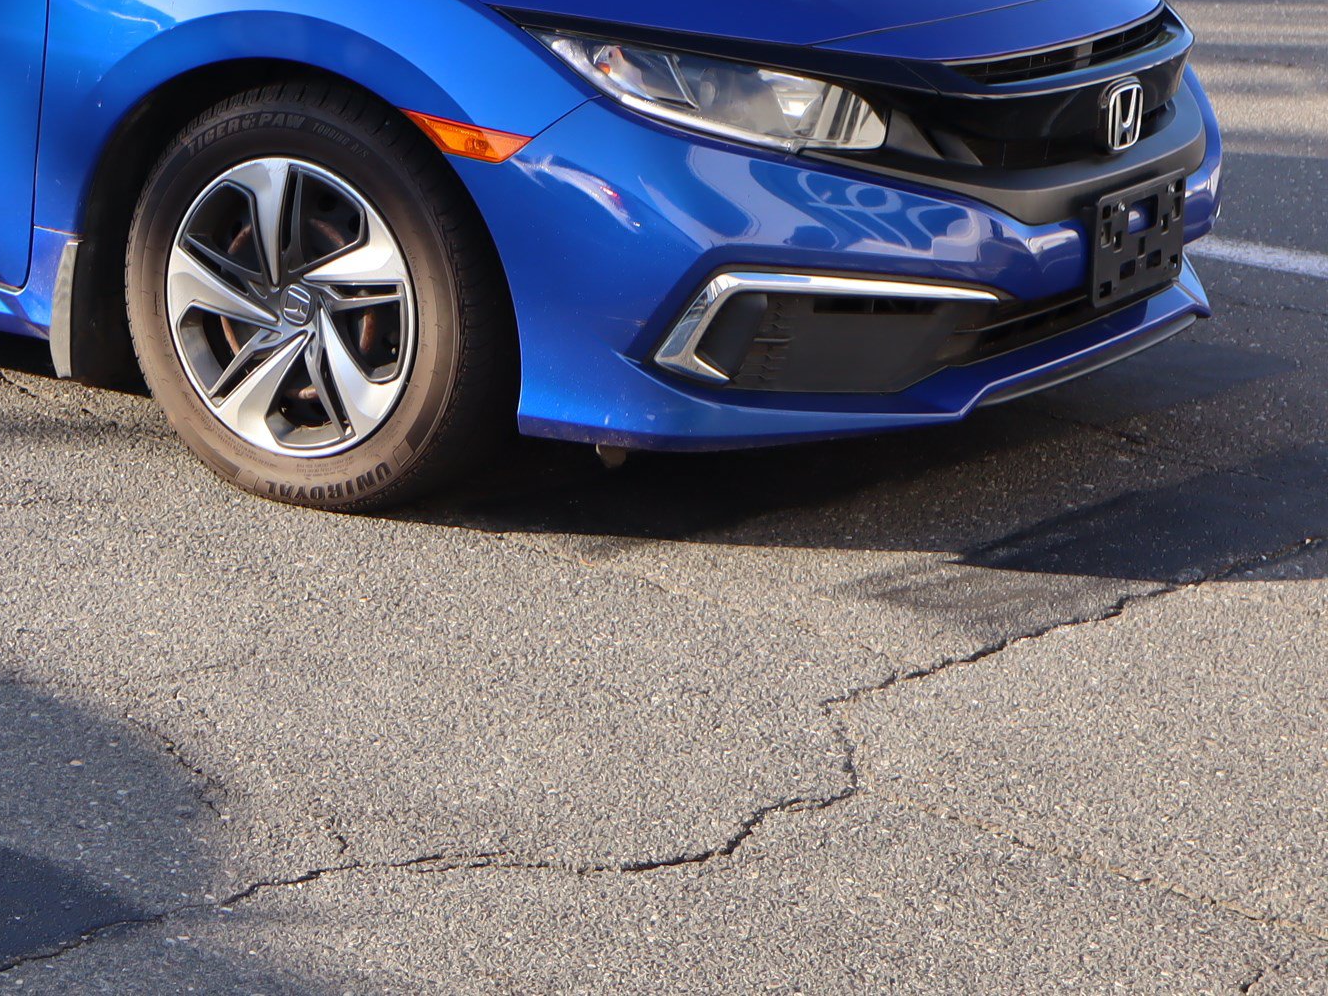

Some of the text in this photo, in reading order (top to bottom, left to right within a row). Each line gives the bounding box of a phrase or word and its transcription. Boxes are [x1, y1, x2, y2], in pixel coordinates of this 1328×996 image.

[186, 116, 240, 157] TIGER
[258, 113, 307, 130] PAW
[264, 460, 394, 502] UNIROYAL
